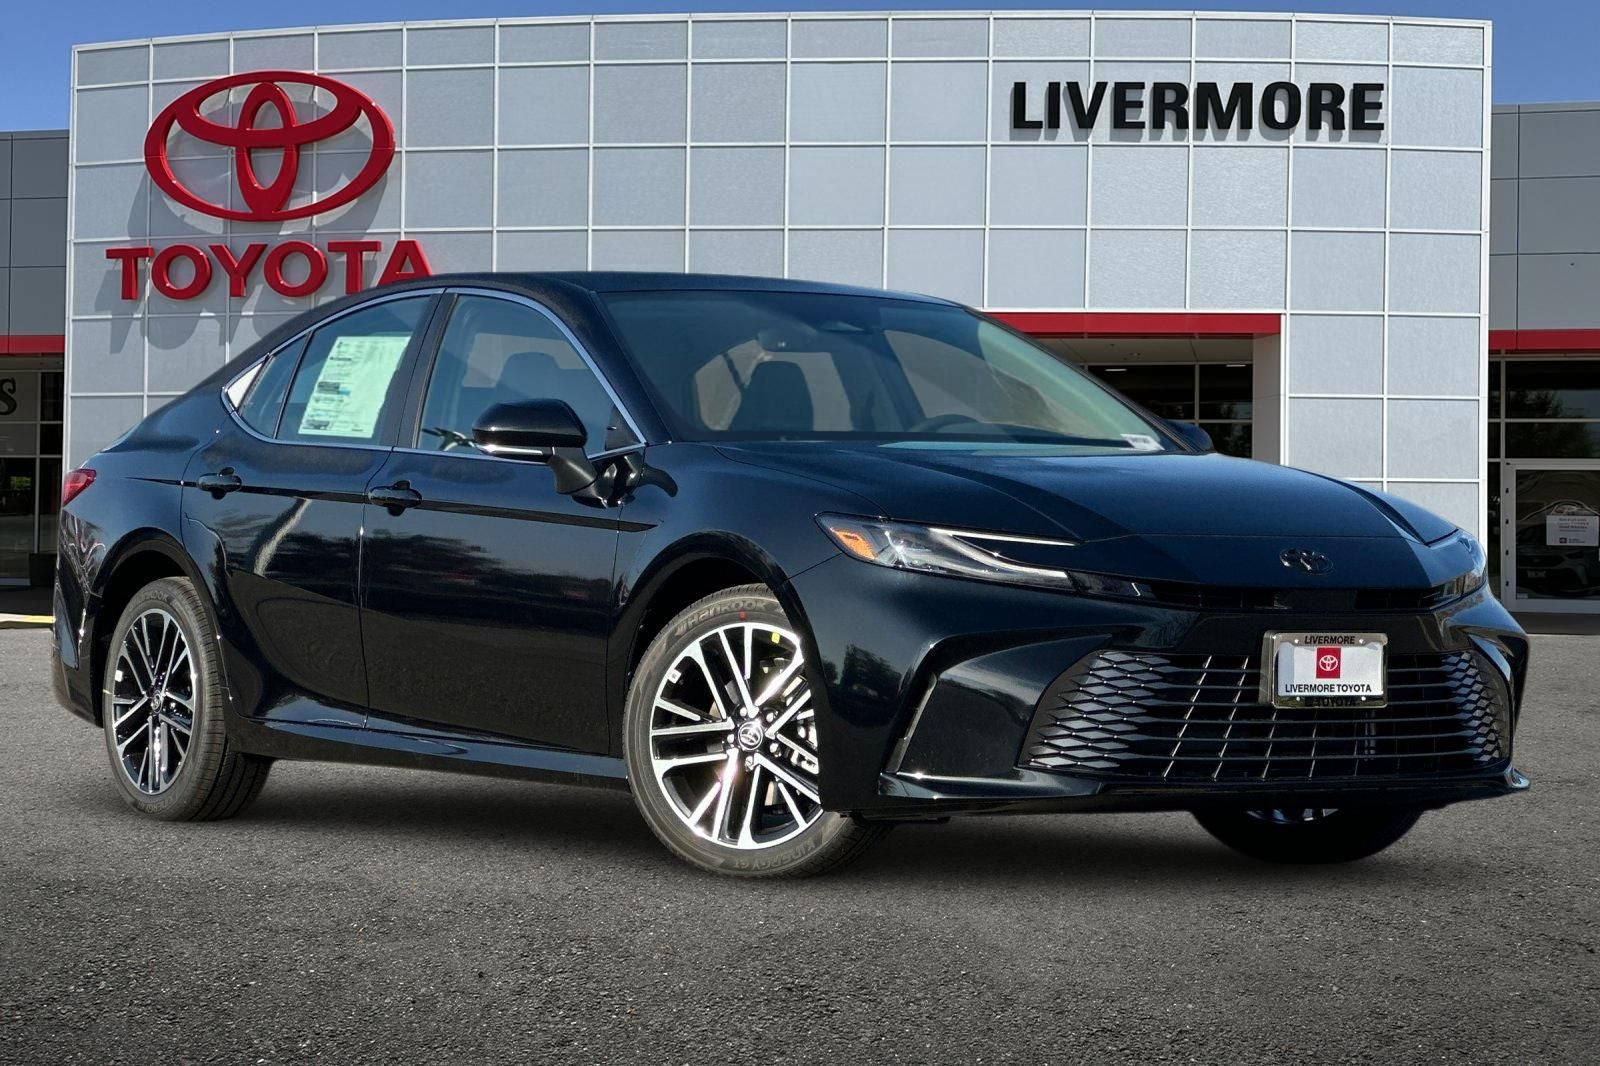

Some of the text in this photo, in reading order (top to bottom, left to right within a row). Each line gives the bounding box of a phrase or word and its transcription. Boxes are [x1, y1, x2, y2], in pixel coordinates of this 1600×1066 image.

[1012, 81, 1385, 131] LIVERMORE
[105, 239, 432, 300] TOYOTA
[1304, 635, 1356, 645] LIVERMORE
[1285, 684, 1372, 693] LIVERMORE TOYOTA
